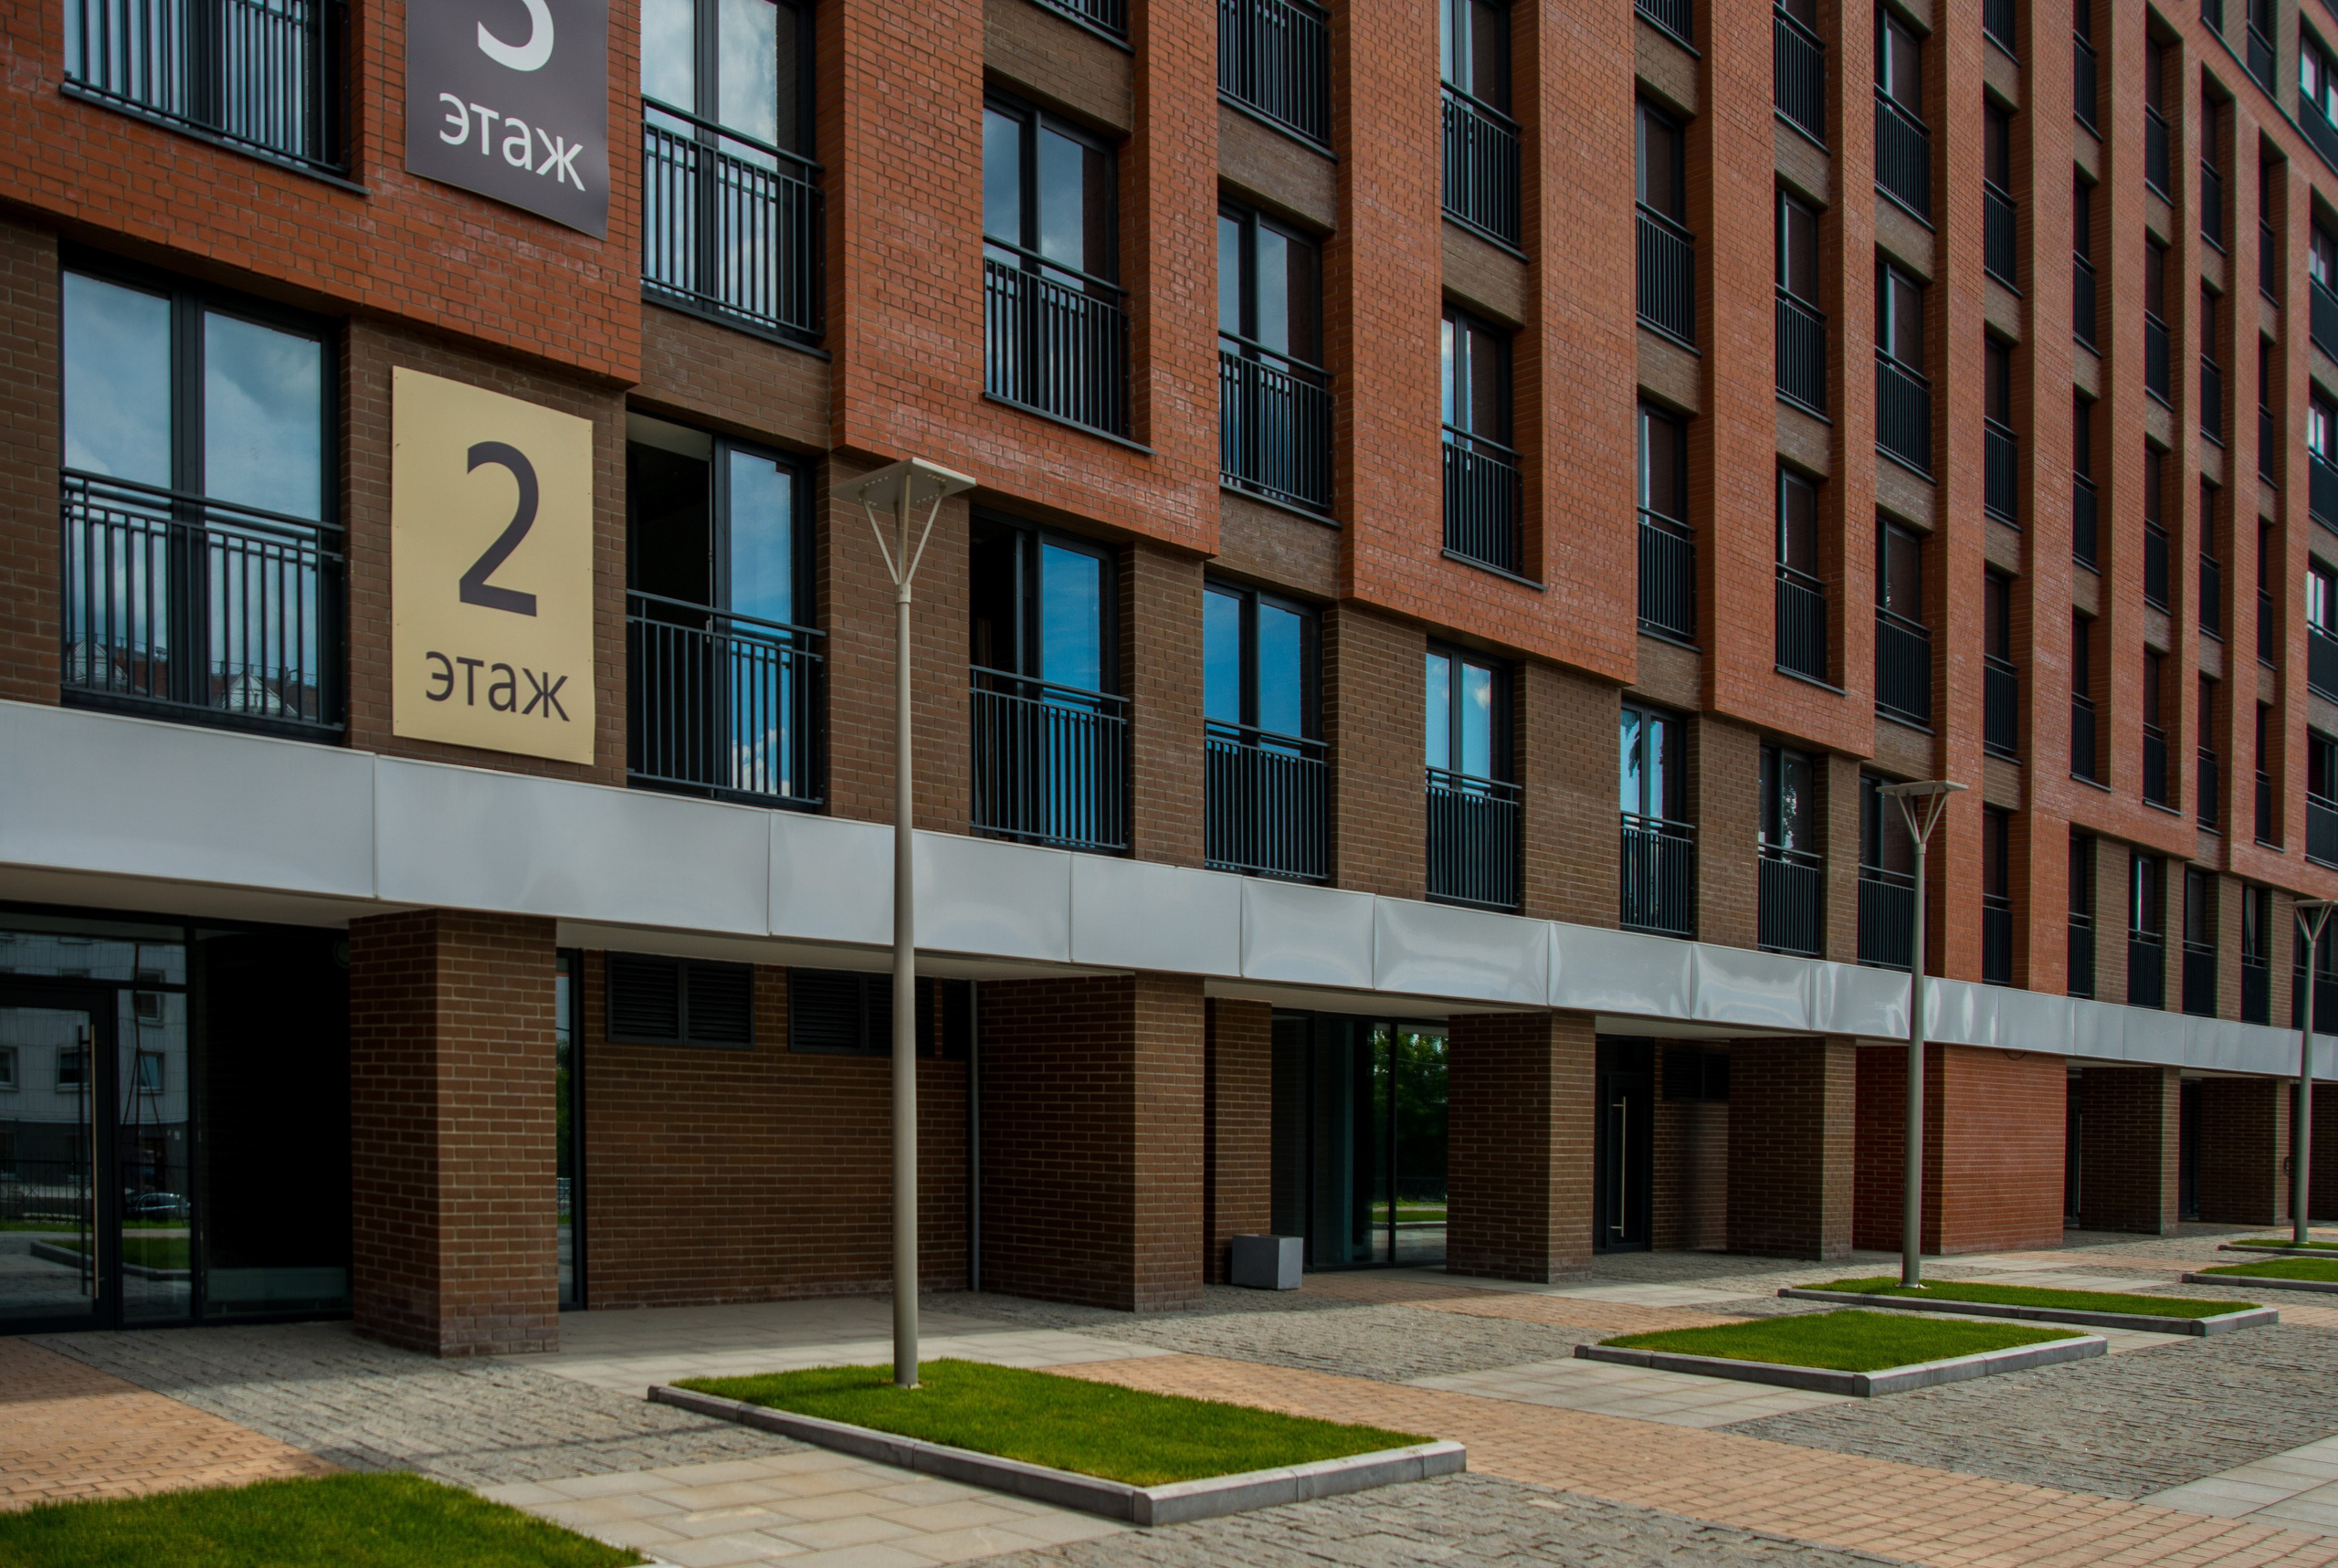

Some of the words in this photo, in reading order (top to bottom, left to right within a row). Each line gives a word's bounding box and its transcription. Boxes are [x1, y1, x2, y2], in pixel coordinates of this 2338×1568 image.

[439, 92, 585, 192] этаж
[458, 440, 540, 617] 2
[426, 650, 571, 722] этаж
